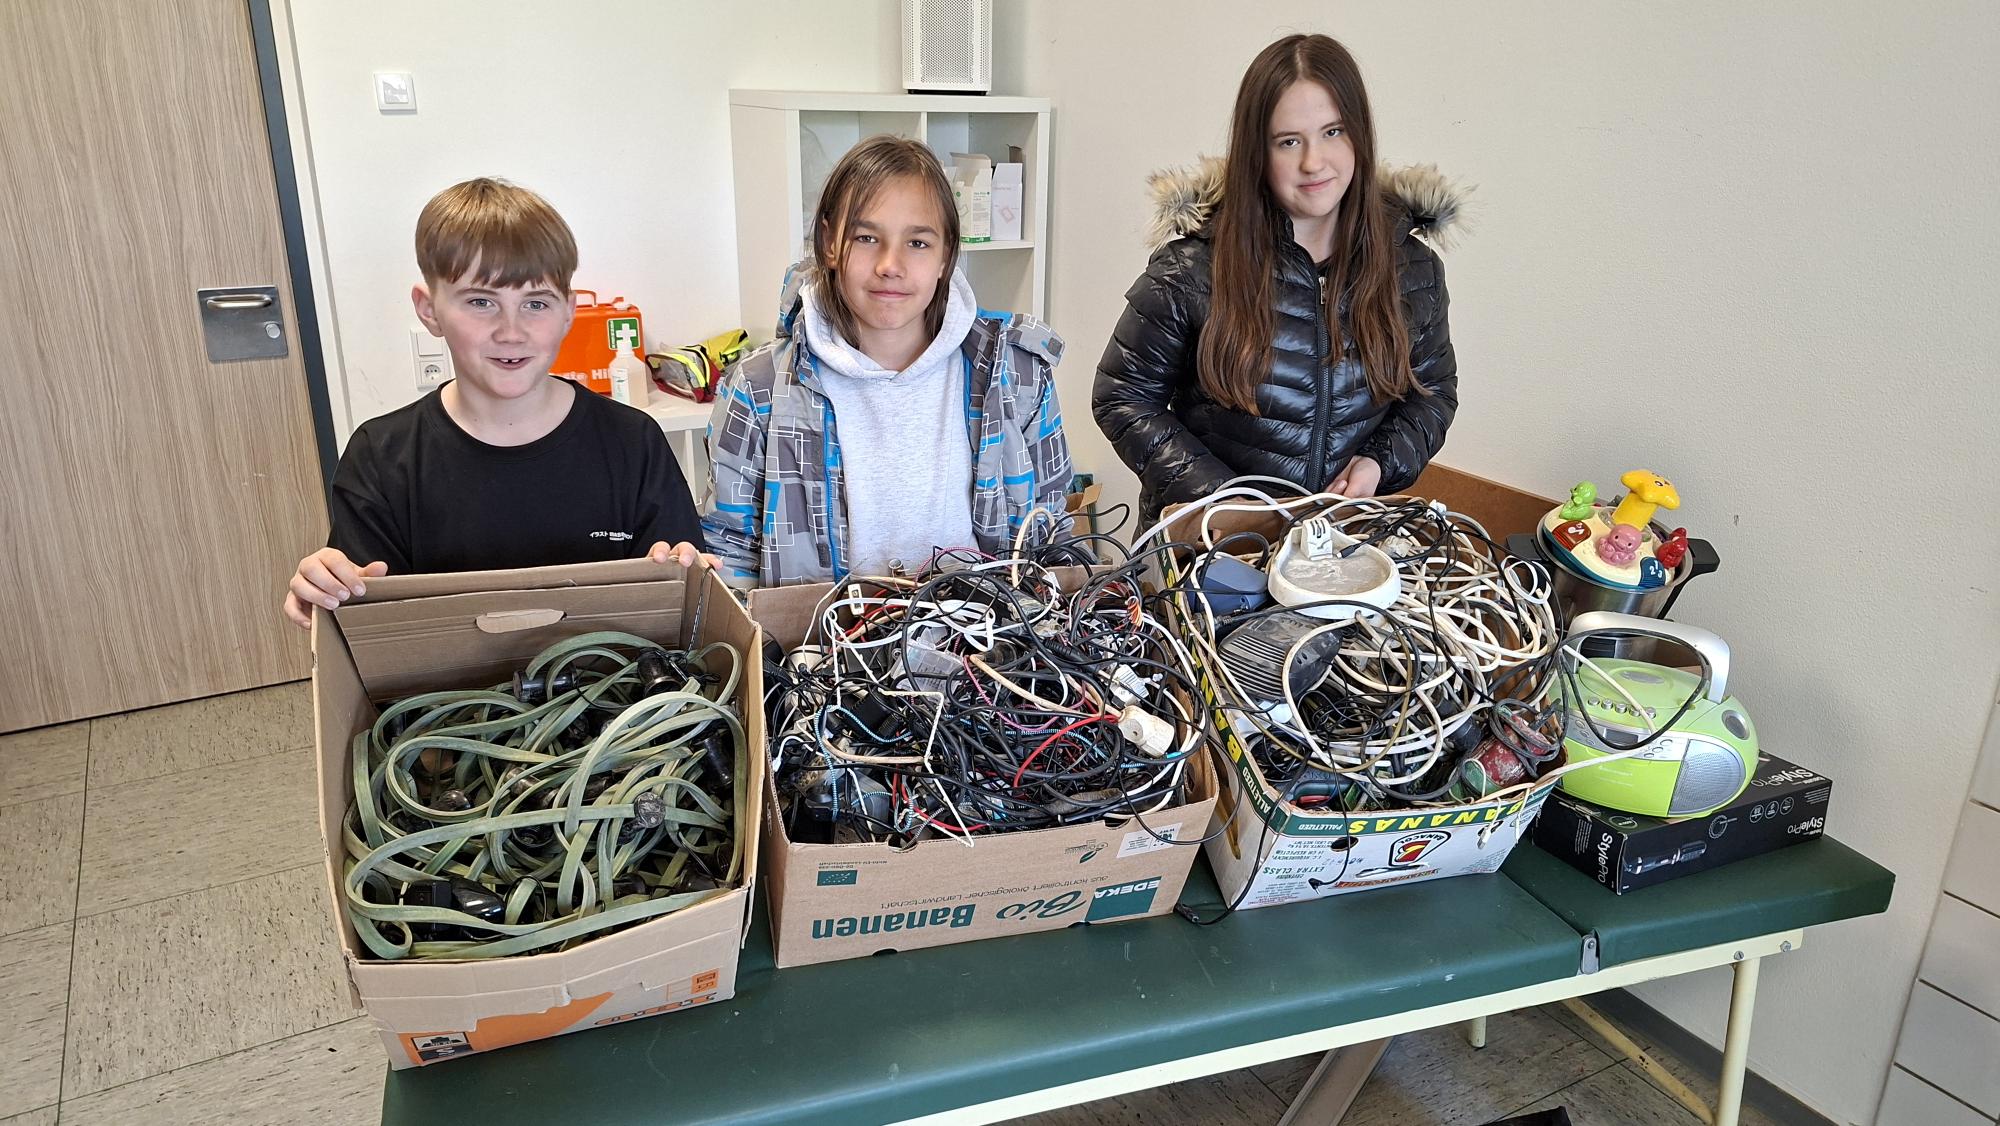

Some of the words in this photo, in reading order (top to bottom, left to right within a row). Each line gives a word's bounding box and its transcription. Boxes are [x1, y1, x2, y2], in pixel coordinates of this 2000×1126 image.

[1649, 566, 1656, 575] 2
[1750, 769, 1813, 787] StylePro
[1242, 766, 1272, 814] ALLETIZED
[1349, 800, 1524, 834] BANANAS
[1787, 816, 1824, 834] StylePro
[1298, 823, 1343, 831] PALLETIZED
[1399, 831, 1445, 845] BANACOL
[1597, 832, 1613, 883] StylePro
[1089, 875, 1109, 884] aus
[1262, 867, 1292, 875] CLASS
[1032, 877, 1088, 892] kontrolliert
[1094, 877, 1160, 899] EDEKA
[880, 894, 962, 910] Landwirtschaft
[964, 886, 1031, 901] ökologischer
[995, 889, 1087, 921] Bio
[812, 903, 976, 940] Bananen
